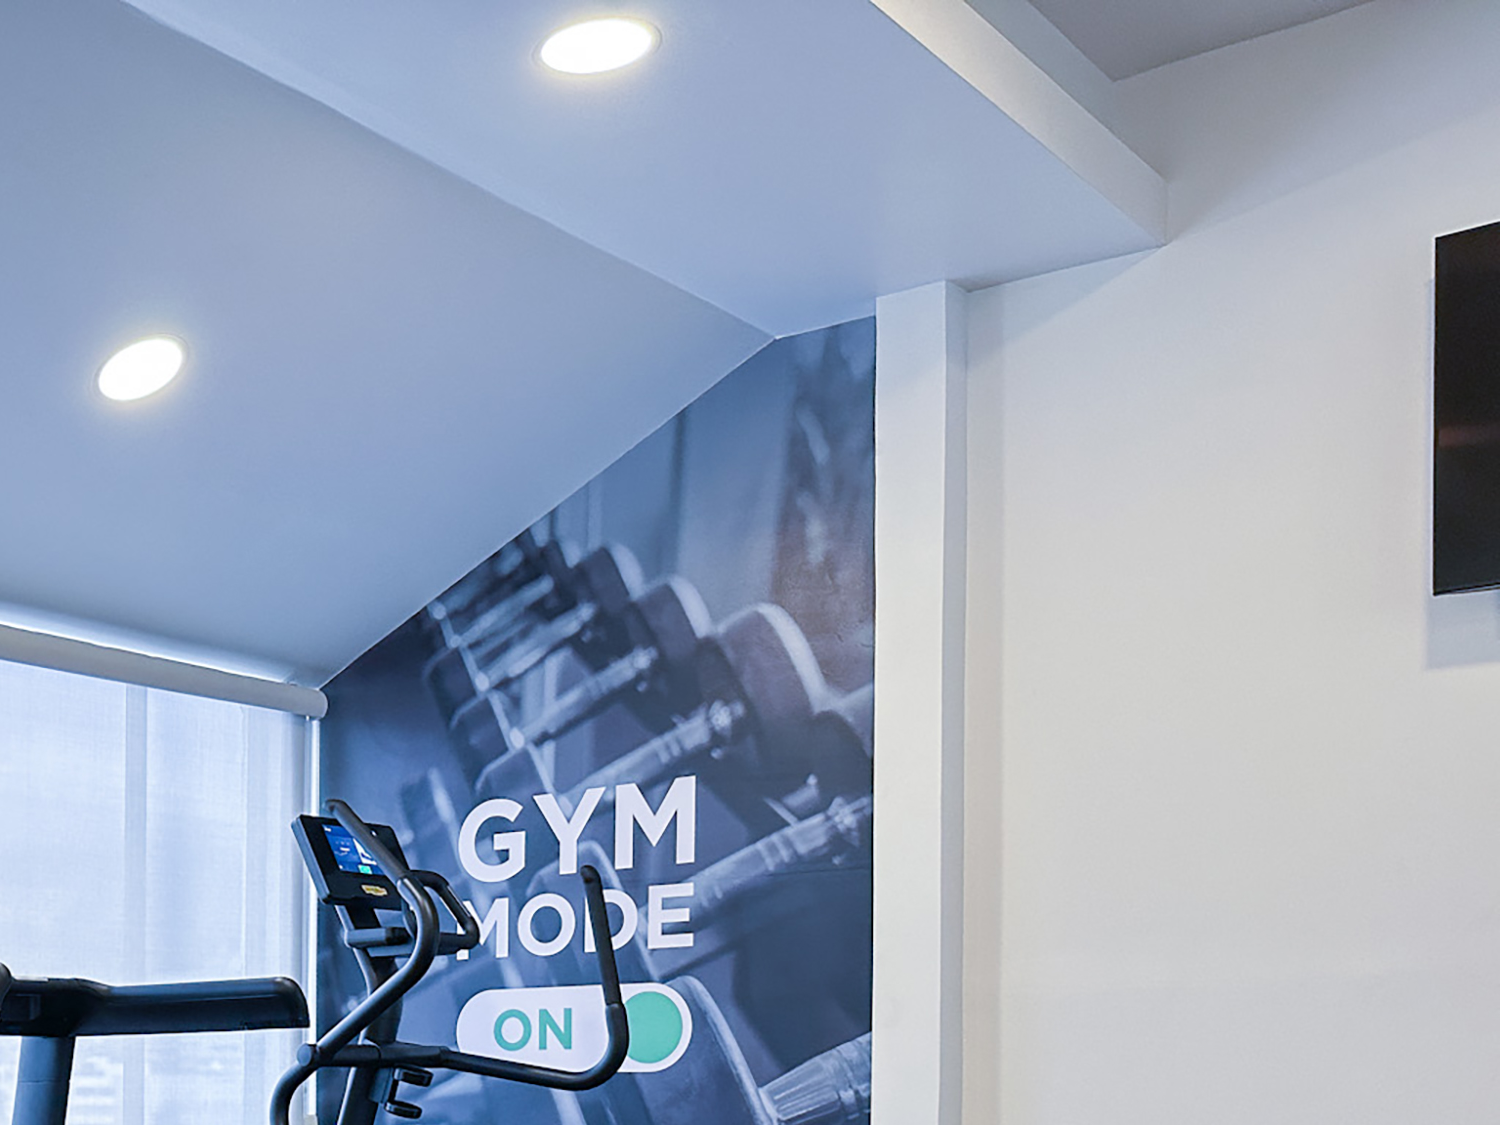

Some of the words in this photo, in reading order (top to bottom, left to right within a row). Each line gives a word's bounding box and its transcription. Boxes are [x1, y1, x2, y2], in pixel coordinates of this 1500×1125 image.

[458, 775, 696, 882] GYM
[457, 882, 694, 960] MODE
[493, 1008, 572, 1051] ON
